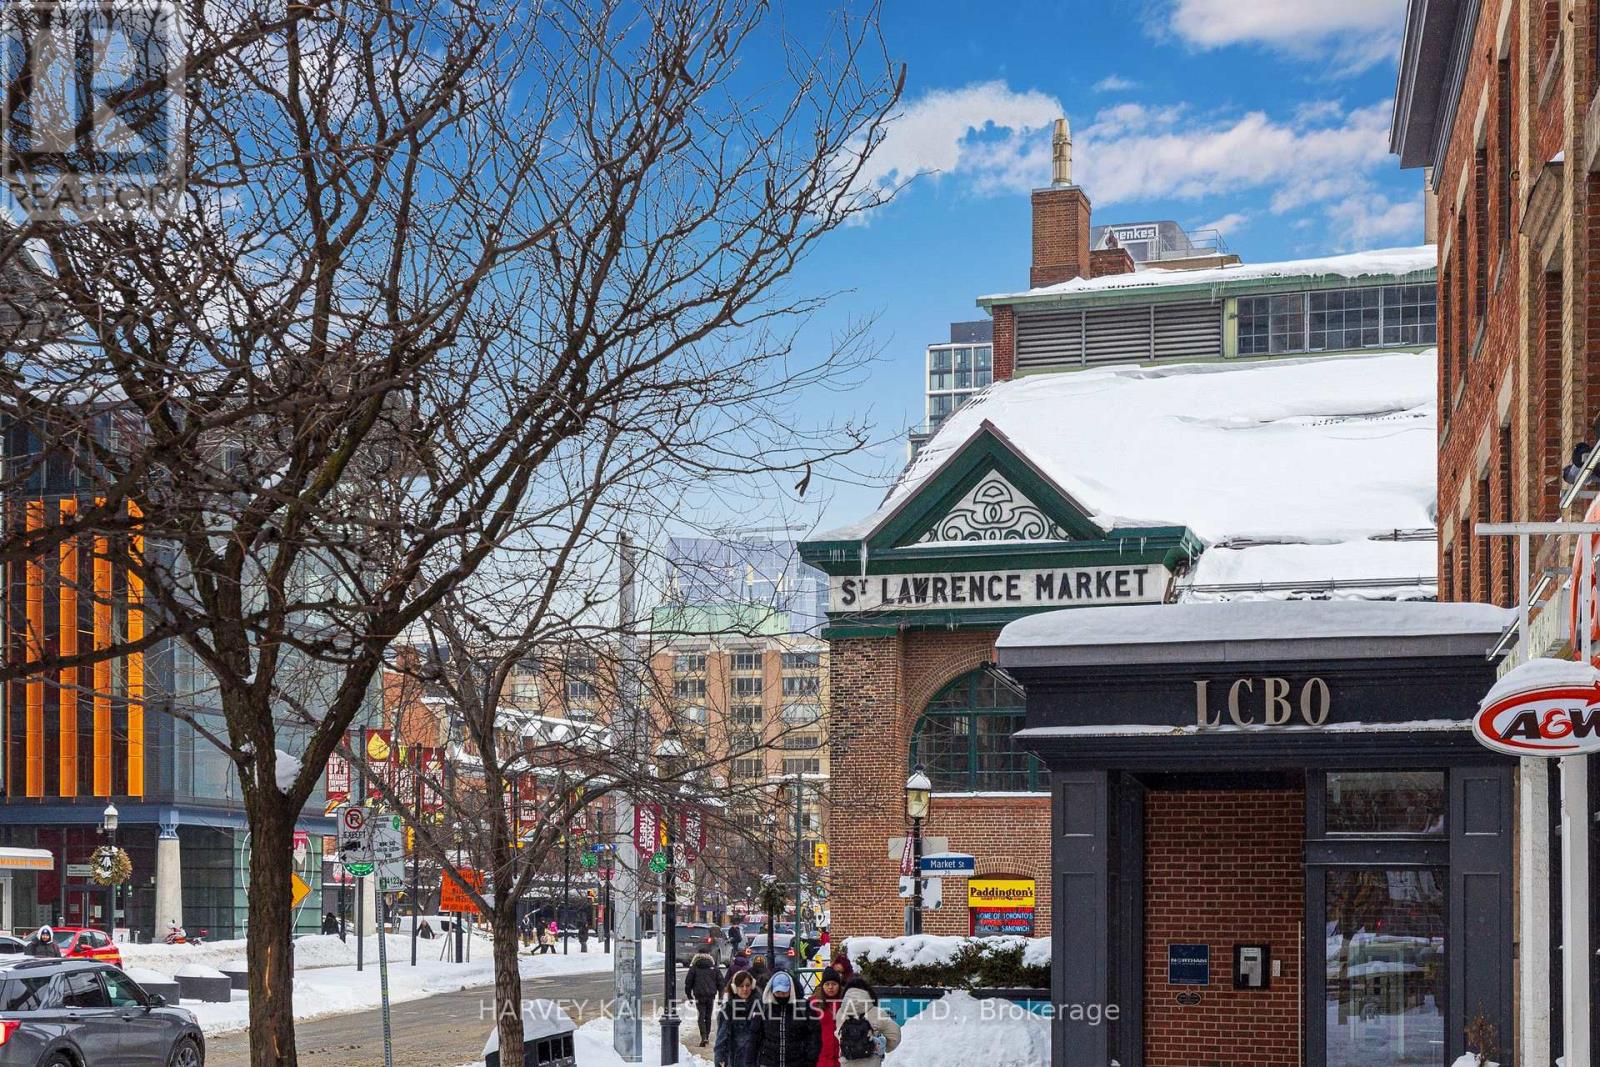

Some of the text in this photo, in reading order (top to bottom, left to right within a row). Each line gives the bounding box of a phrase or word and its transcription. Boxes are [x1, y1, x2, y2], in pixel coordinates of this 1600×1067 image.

[881, 574, 1021, 604] LAWRENCE
[1036, 568, 1149, 600] MARKET
[1193, 677, 1331, 729] LCBO
[930, 859, 956, 869] Market
[970, 887, 1033, 899] Paddington's
